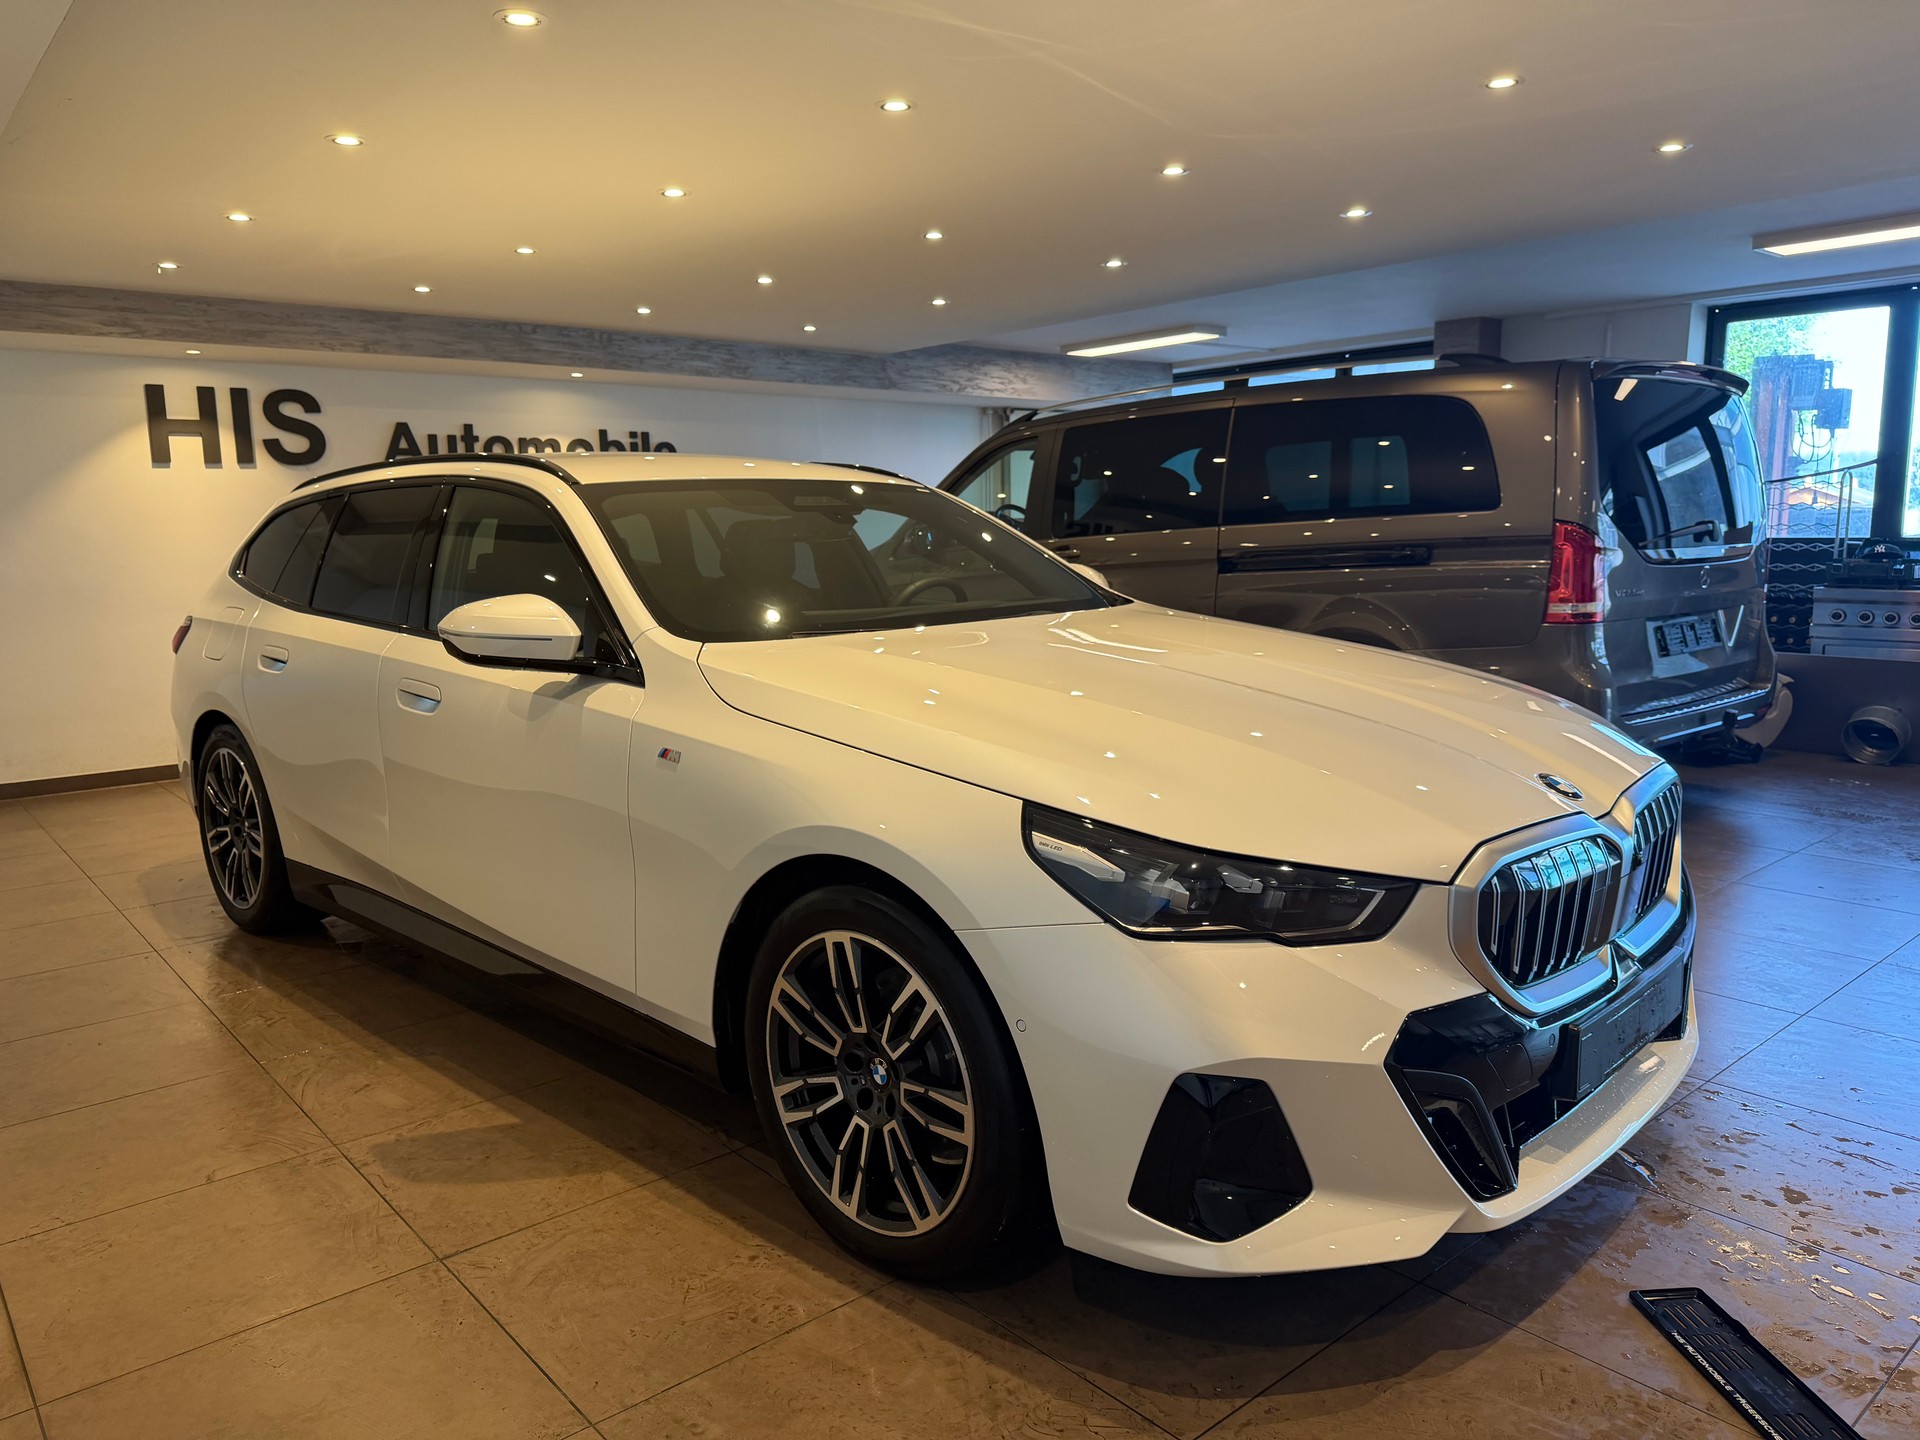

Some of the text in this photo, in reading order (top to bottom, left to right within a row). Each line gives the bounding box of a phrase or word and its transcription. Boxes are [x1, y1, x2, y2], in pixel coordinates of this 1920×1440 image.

[144, 383, 327, 469] HIS
[1671, 1332, 1688, 1344] HIS
[1684, 1345, 1734, 1391] AUTOMOBILE
